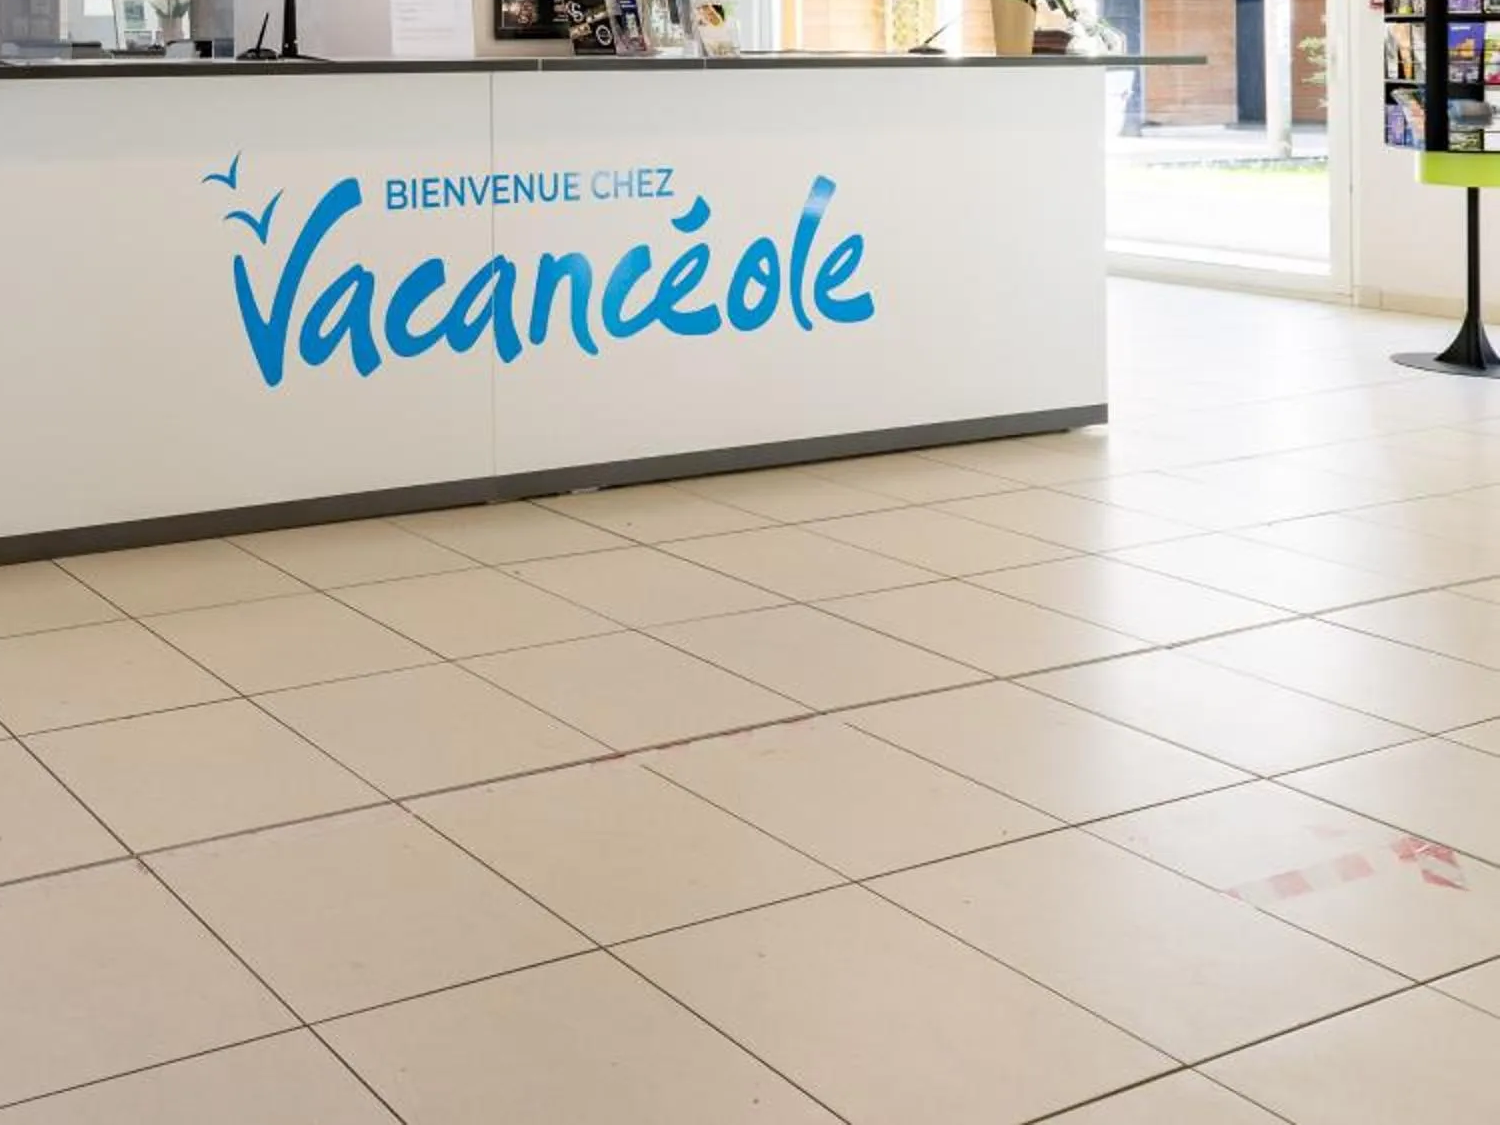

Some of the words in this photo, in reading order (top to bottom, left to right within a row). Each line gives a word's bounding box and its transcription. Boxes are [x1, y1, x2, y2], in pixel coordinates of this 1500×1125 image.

[385, 171, 581, 211] BIENVENUE
[590, 168, 674, 202] CHEZ
[233, 174, 876, 388] Vacancéole
